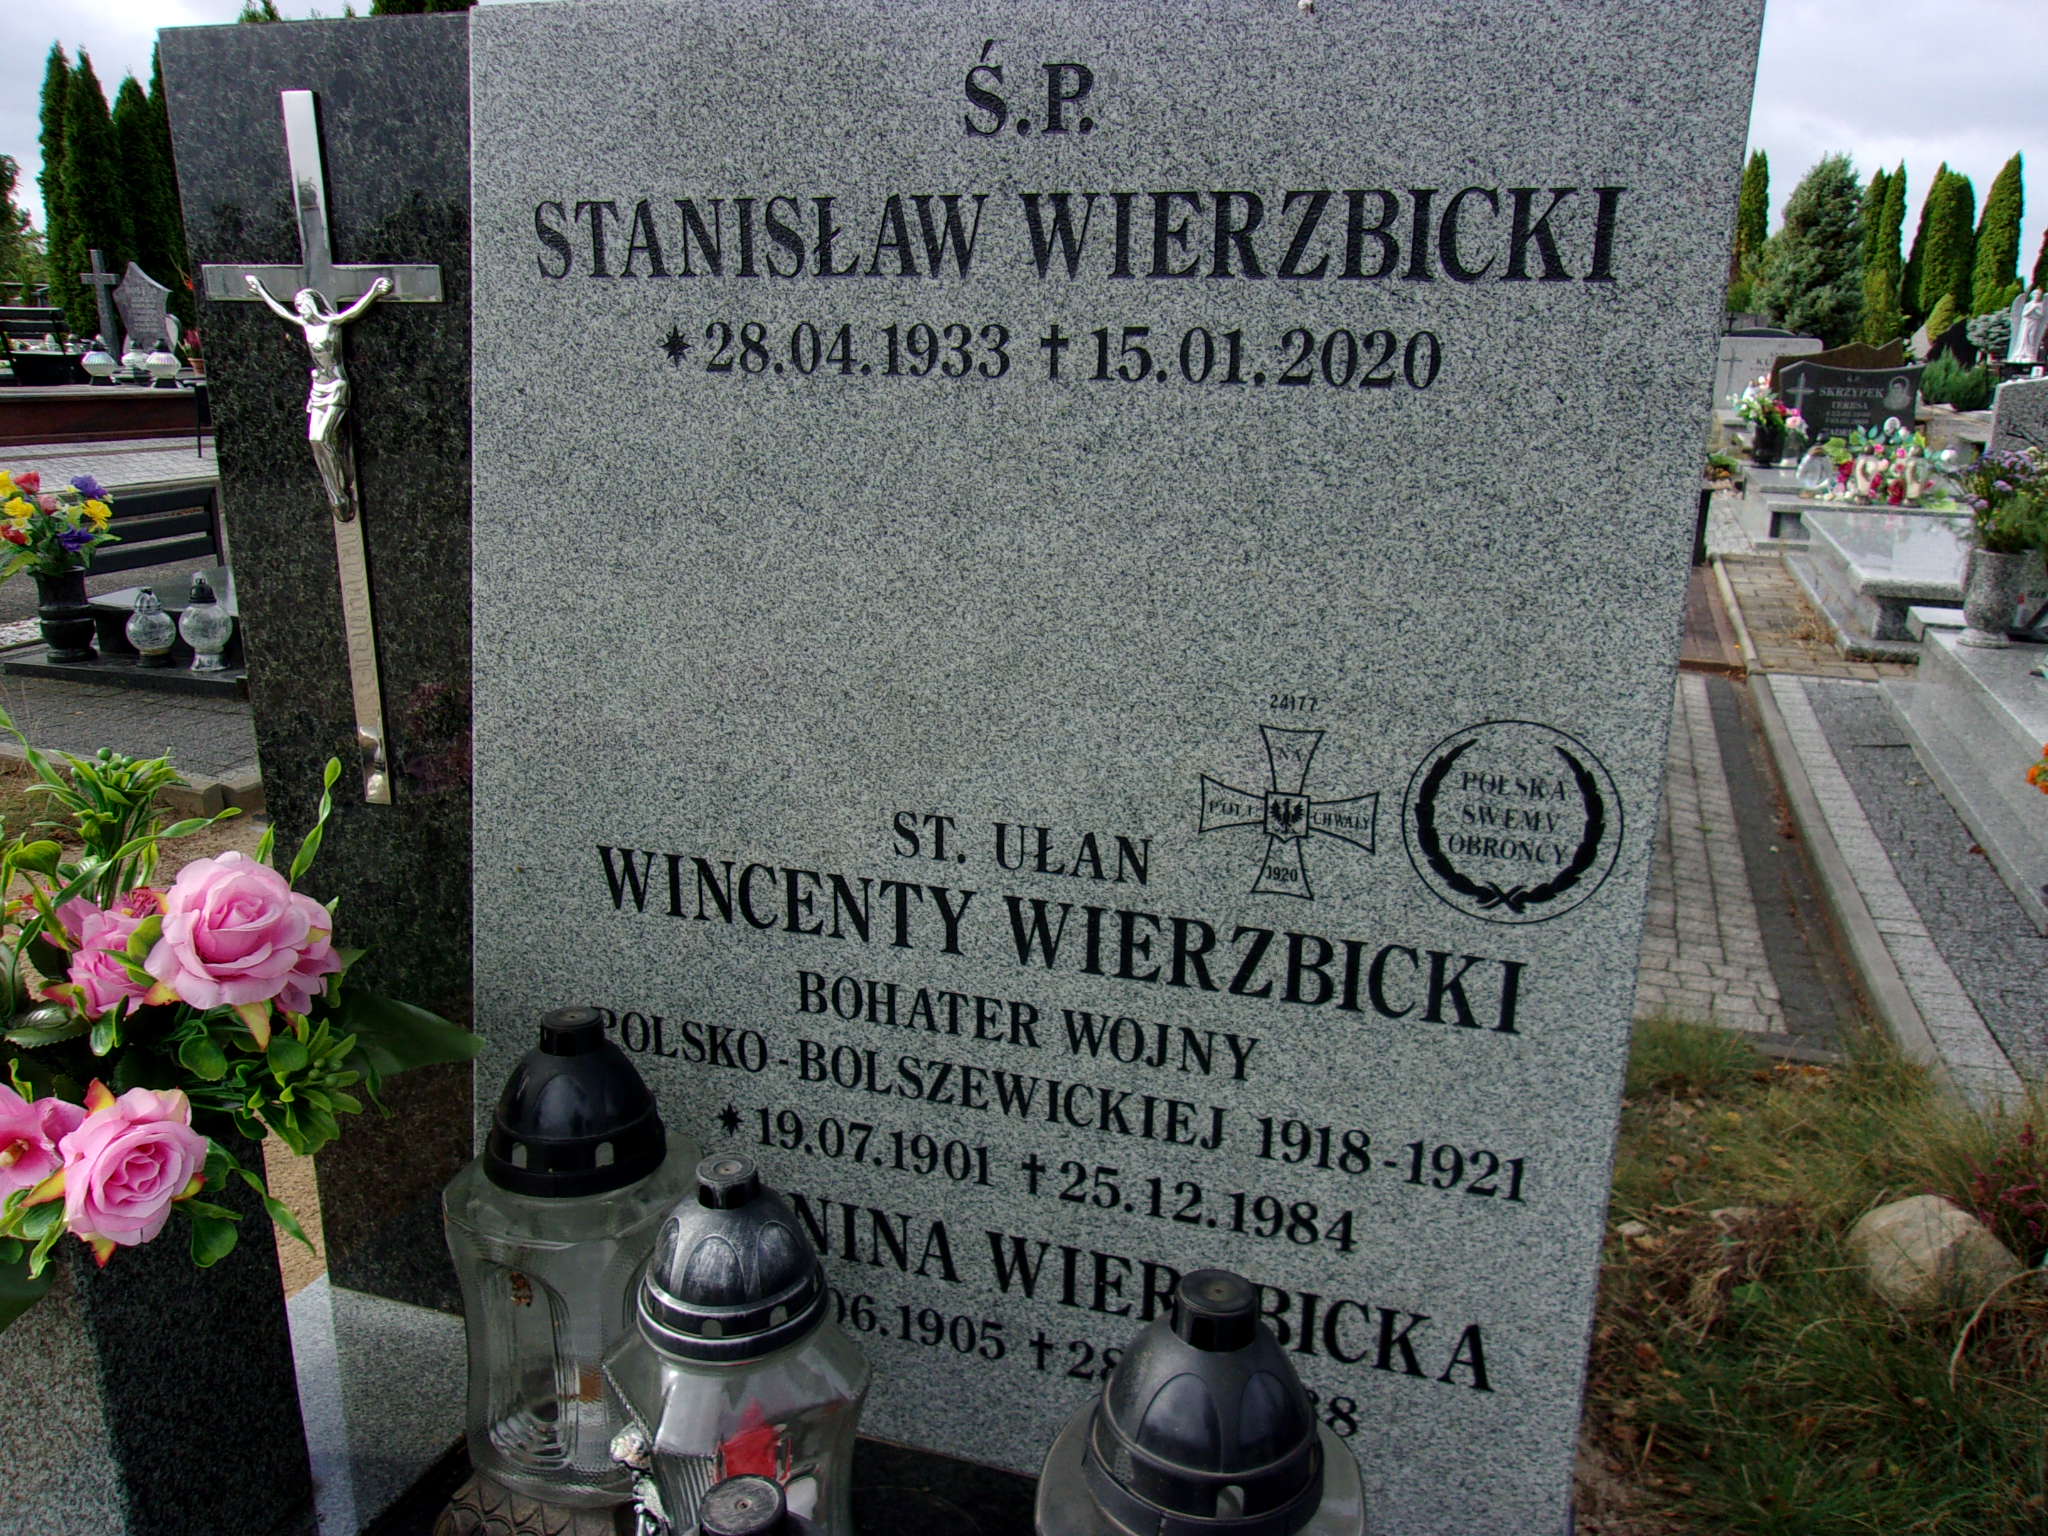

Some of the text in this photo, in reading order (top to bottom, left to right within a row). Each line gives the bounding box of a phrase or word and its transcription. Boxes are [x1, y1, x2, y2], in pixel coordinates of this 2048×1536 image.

[964, 39, 1095, 137] Ś.P.
[534, 186, 1629, 284] STANISŁAW WIERZBICKI
[705, 321, 1443, 390] 28.04.1933 15.01.2020
[1270, 693, 1319, 712] 24177
[1461, 771, 1566, 801] POLSKA
[893, 811, 1150, 886] ST. UŁAN
[1265, 864, 1299, 882] 1920
[597, 845, 1529, 1035] WINCENTY WIERZBICKI
[798, 970, 1259, 1081] BOHATER WOJNY
[757, 1107, 1357, 1253] 19.07.1901 25.12.1984
[985, 1230, 1494, 1393] WIERBICKA
